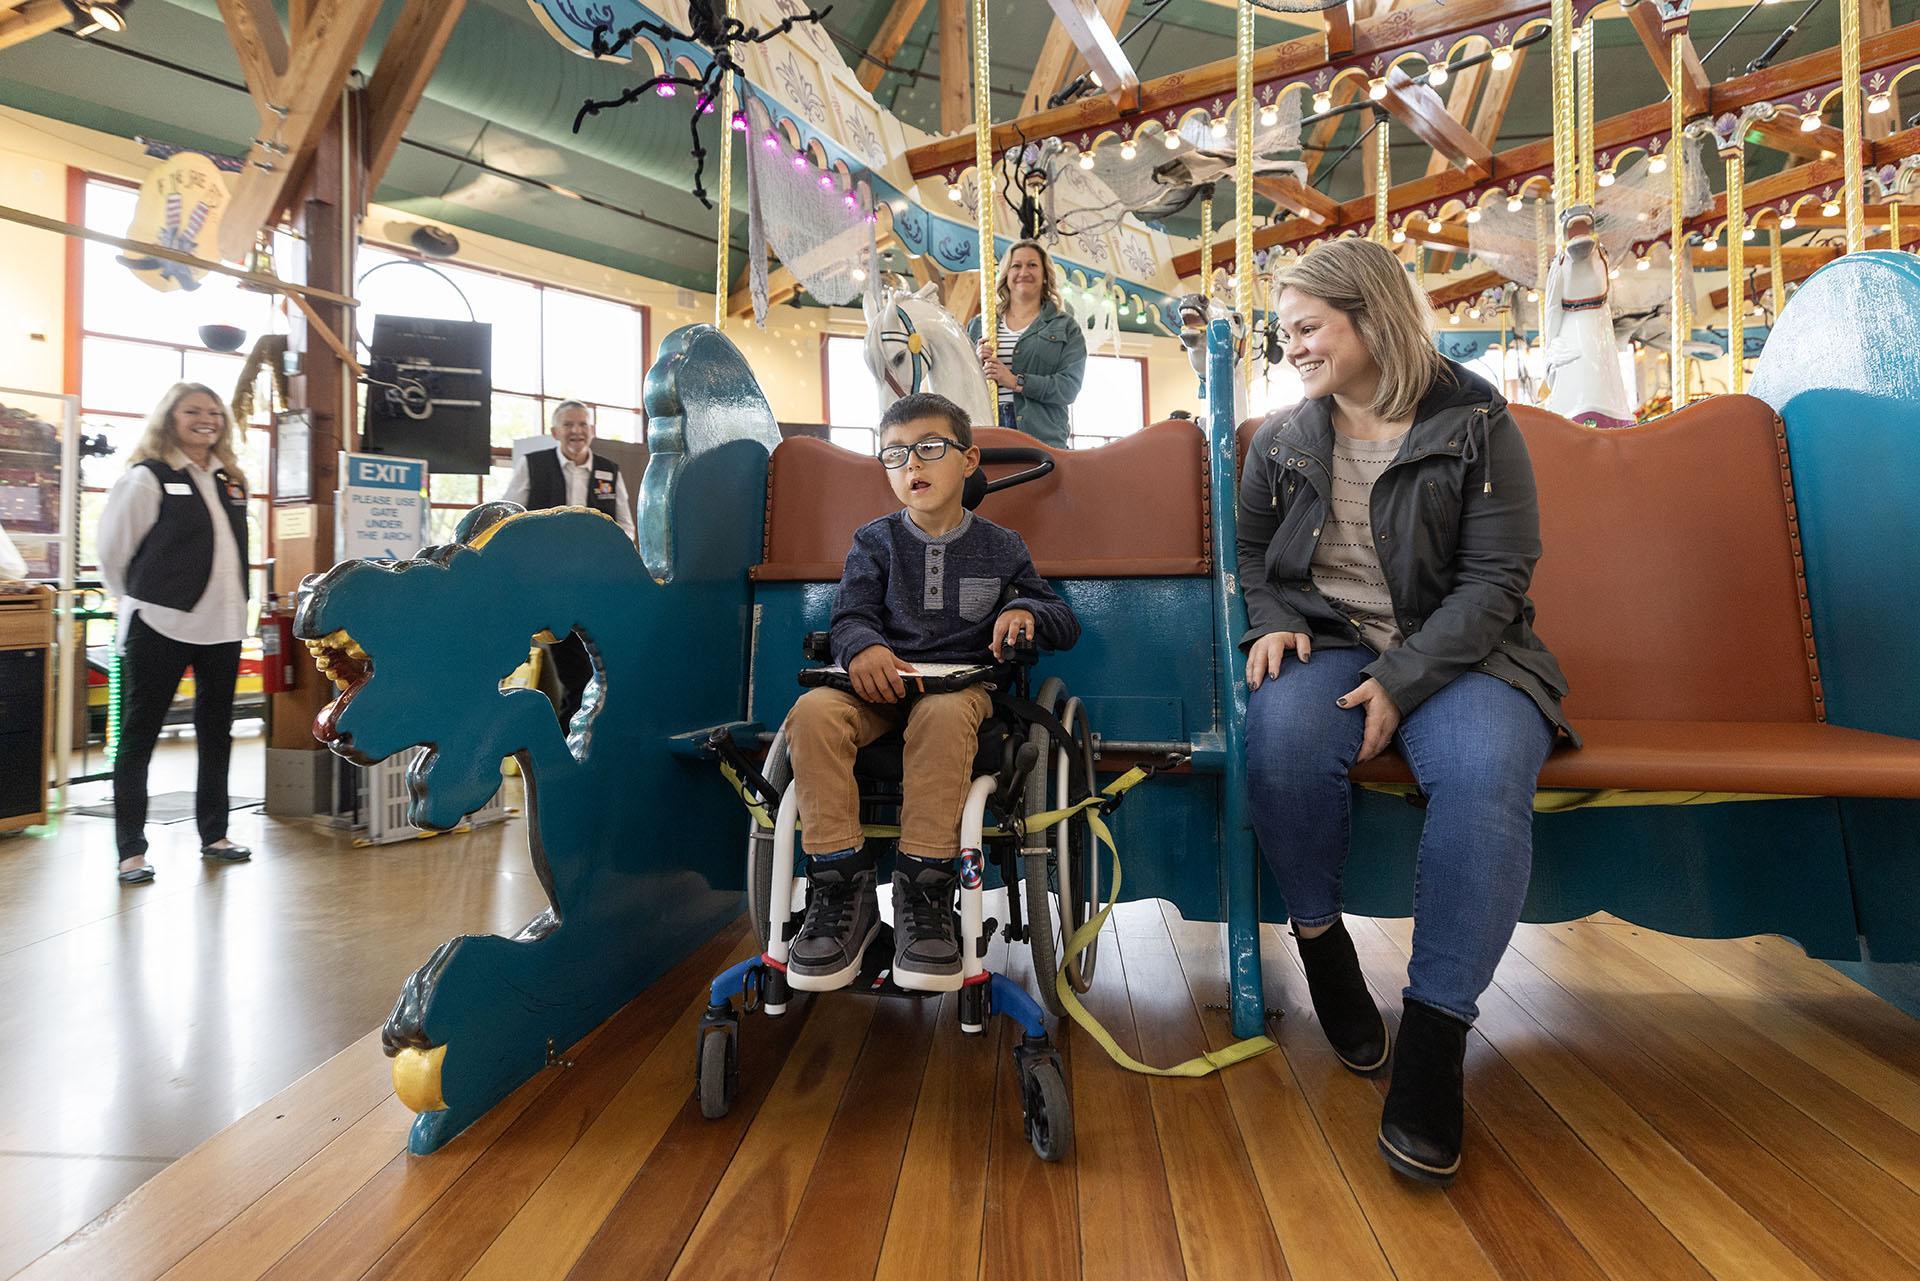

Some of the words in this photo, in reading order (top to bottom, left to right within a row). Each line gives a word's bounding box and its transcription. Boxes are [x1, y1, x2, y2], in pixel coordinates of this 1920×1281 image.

[359, 462, 411, 483] EXIT
[352, 494, 391, 505] PLEASE
[396, 497, 416, 507] USE
[370, 508, 398, 517] GATE
[366, 520, 402, 529] UNDER
[357, 531, 378, 540] THE
[383, 532, 411, 540] ARCH
